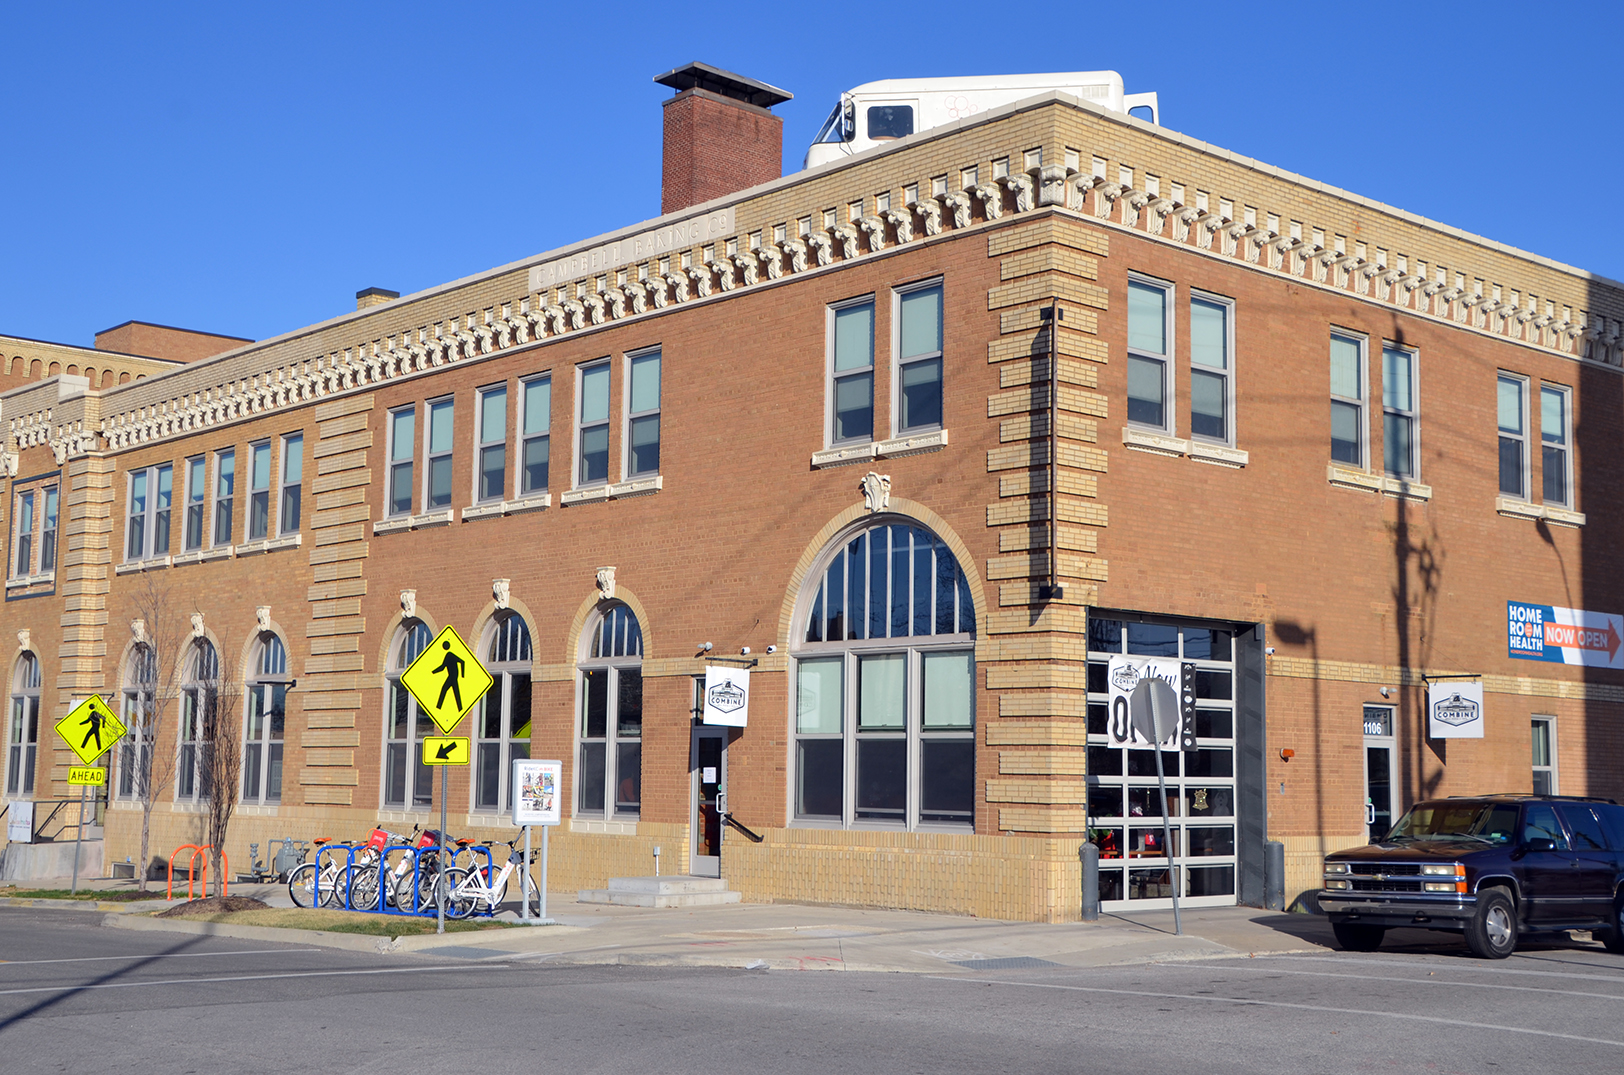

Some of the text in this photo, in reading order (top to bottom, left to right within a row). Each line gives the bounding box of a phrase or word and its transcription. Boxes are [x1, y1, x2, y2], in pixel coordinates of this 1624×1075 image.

[635, 222, 699, 256] BAKING
[1509, 605, 1542, 624] HOME
[1509, 636, 1543, 651] HEALTH
[1546, 626, 1575, 645] NOW
[1577, 630, 1608, 648] OPEN
[711, 697, 742, 706] COMBINE
[1437, 711, 1474, 719] COMBINE
[1363, 721, 1382, 735] 1106
[70, 771, 102, 782] AHEAD
